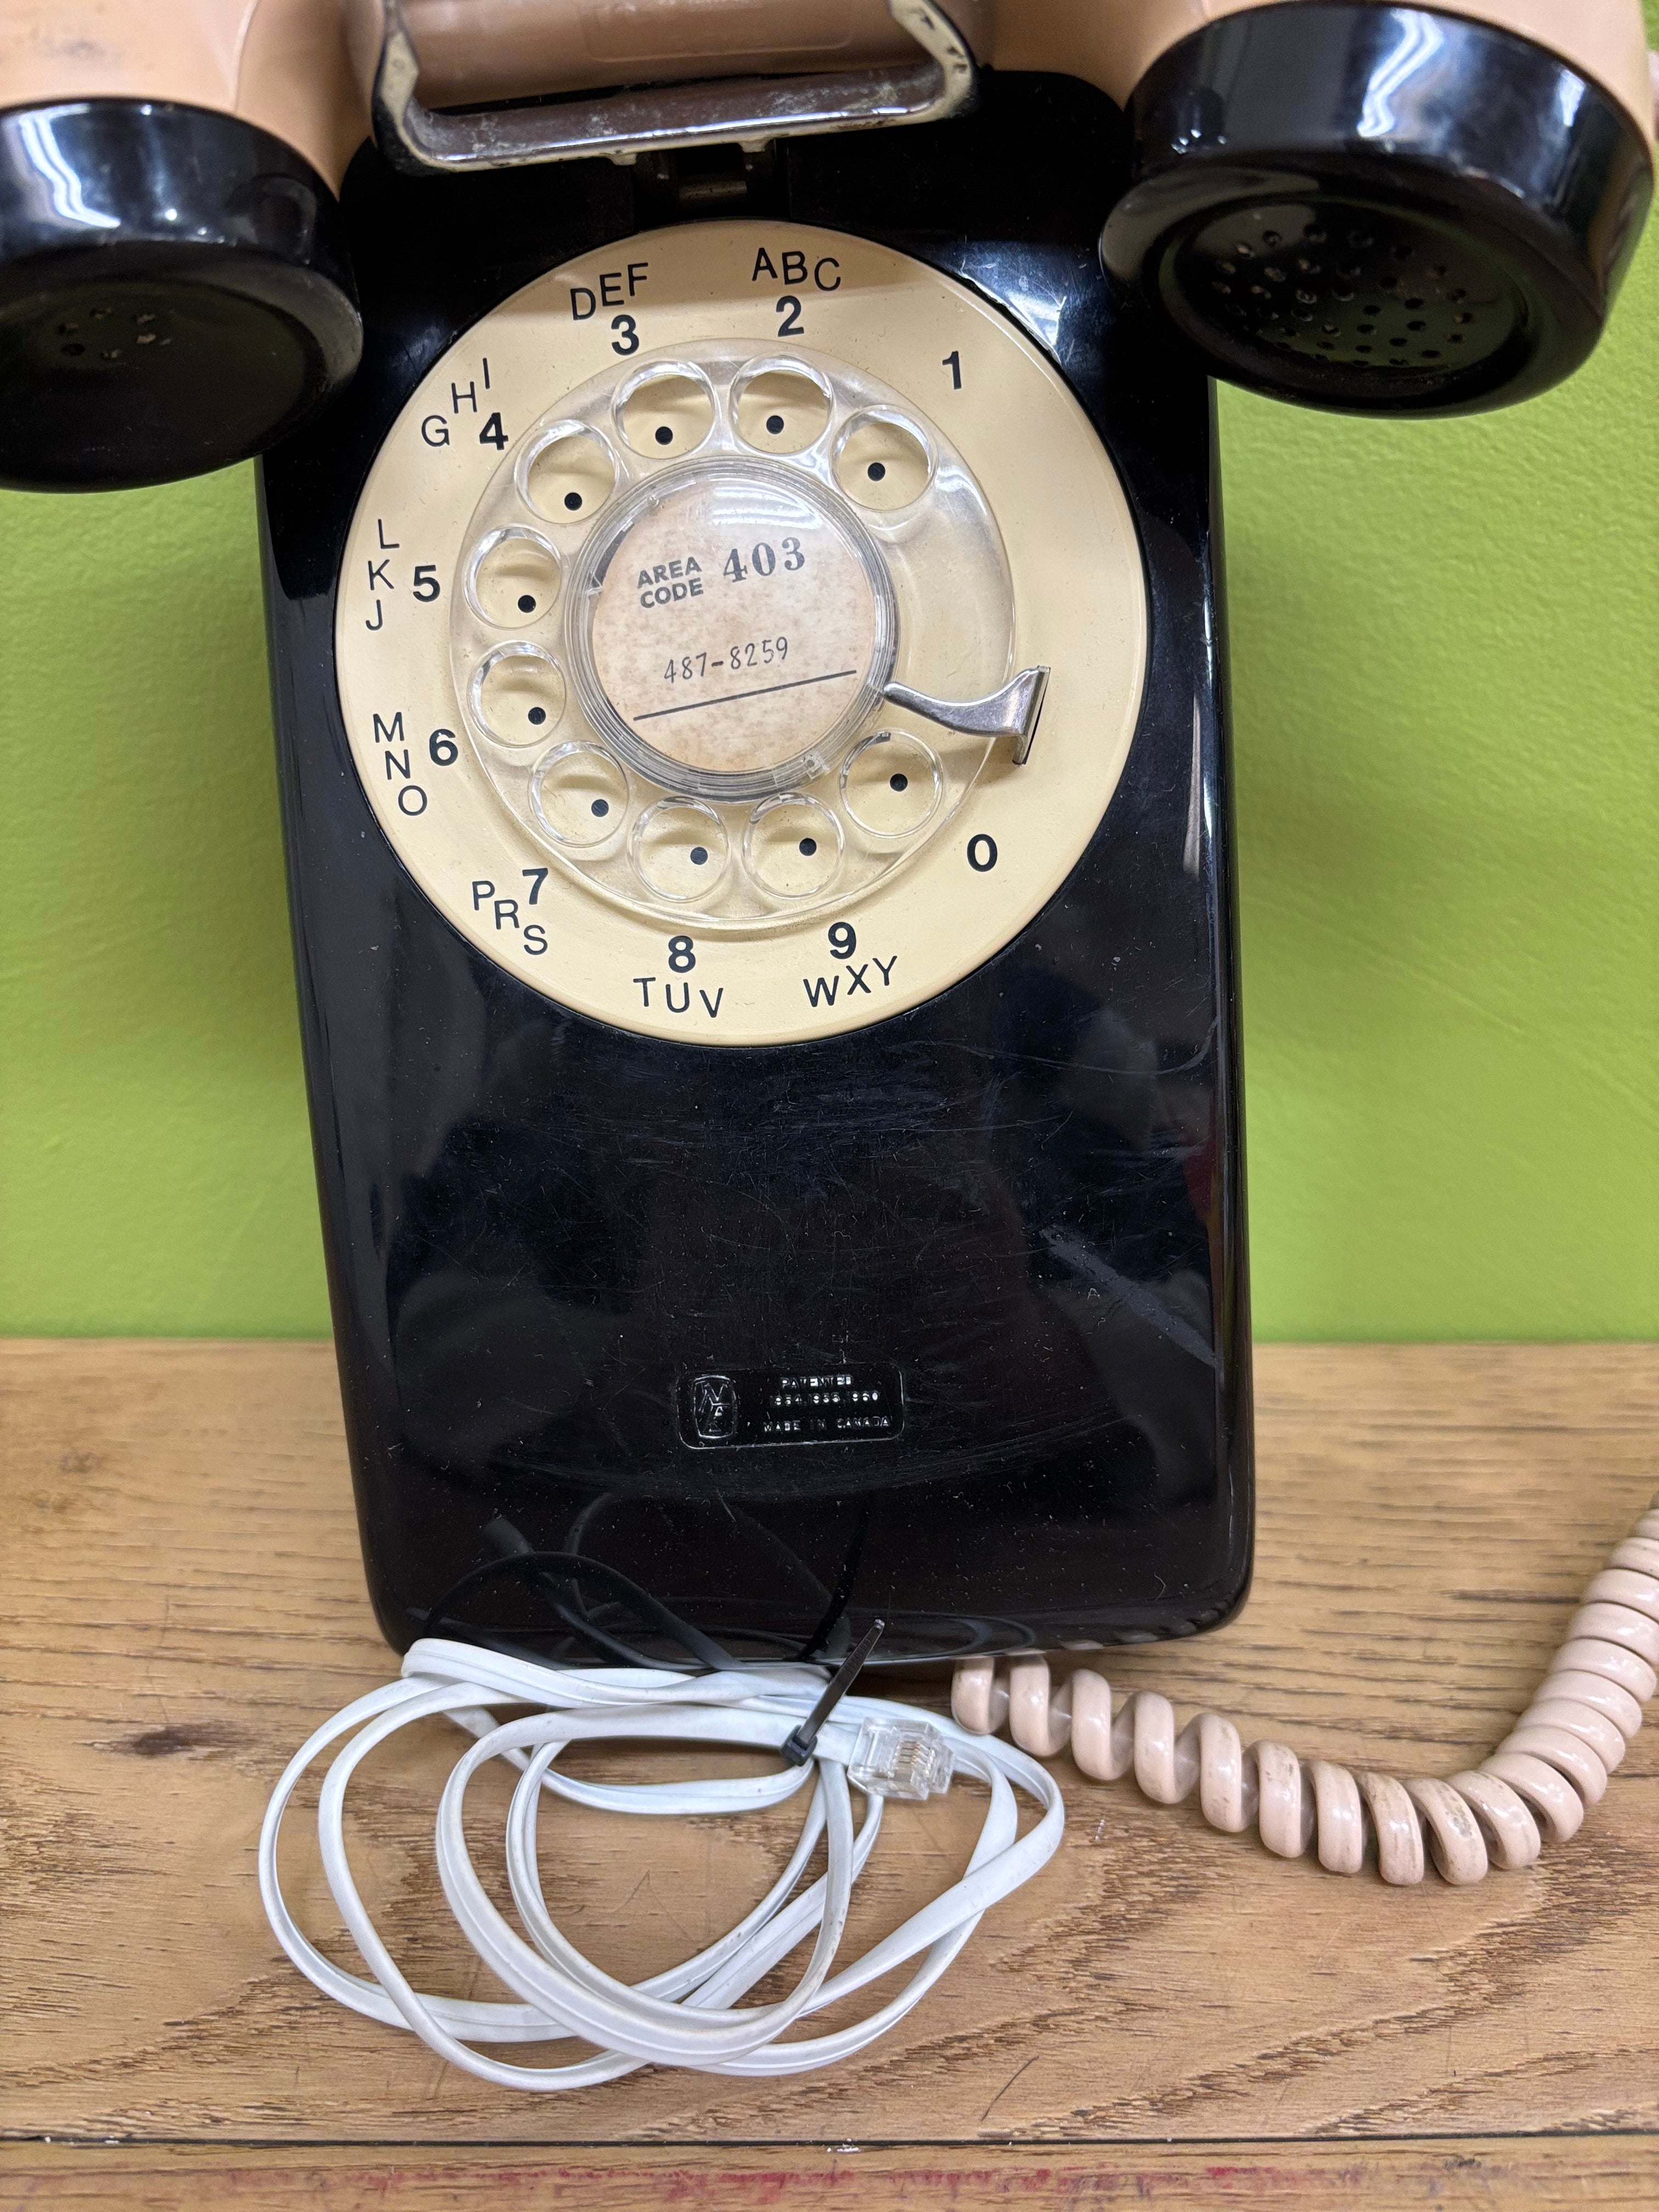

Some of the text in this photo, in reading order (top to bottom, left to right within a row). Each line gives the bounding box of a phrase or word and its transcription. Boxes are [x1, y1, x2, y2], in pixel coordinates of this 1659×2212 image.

[751, 247, 842, 292] ABC
[569, 262, 649, 320] DEF
[611, 314, 639, 356] 3
[776, 295, 804, 337] 2
[942, 351, 962, 390] 1
[479, 412, 509, 450] 4
[637, 556, 702, 589] AREA
[723, 537, 806, 583] 403
[413, 565, 441, 602] 5
[640, 577, 704, 608] CODE
[664, 636, 788, 684] 487-8259
[429, 729, 458, 766] 6
[967, 834, 998, 872] 0
[522, 867, 548, 905] 7
[668, 935, 696, 973] 8
[828, 922, 856, 960] 9
[633, 977, 724, 1018] TUV
[803, 956, 898, 1007] WXY
[780, 1374, 854, 1389] PATENTED
[761, 1415, 890, 1432] MADE IN CANADA
